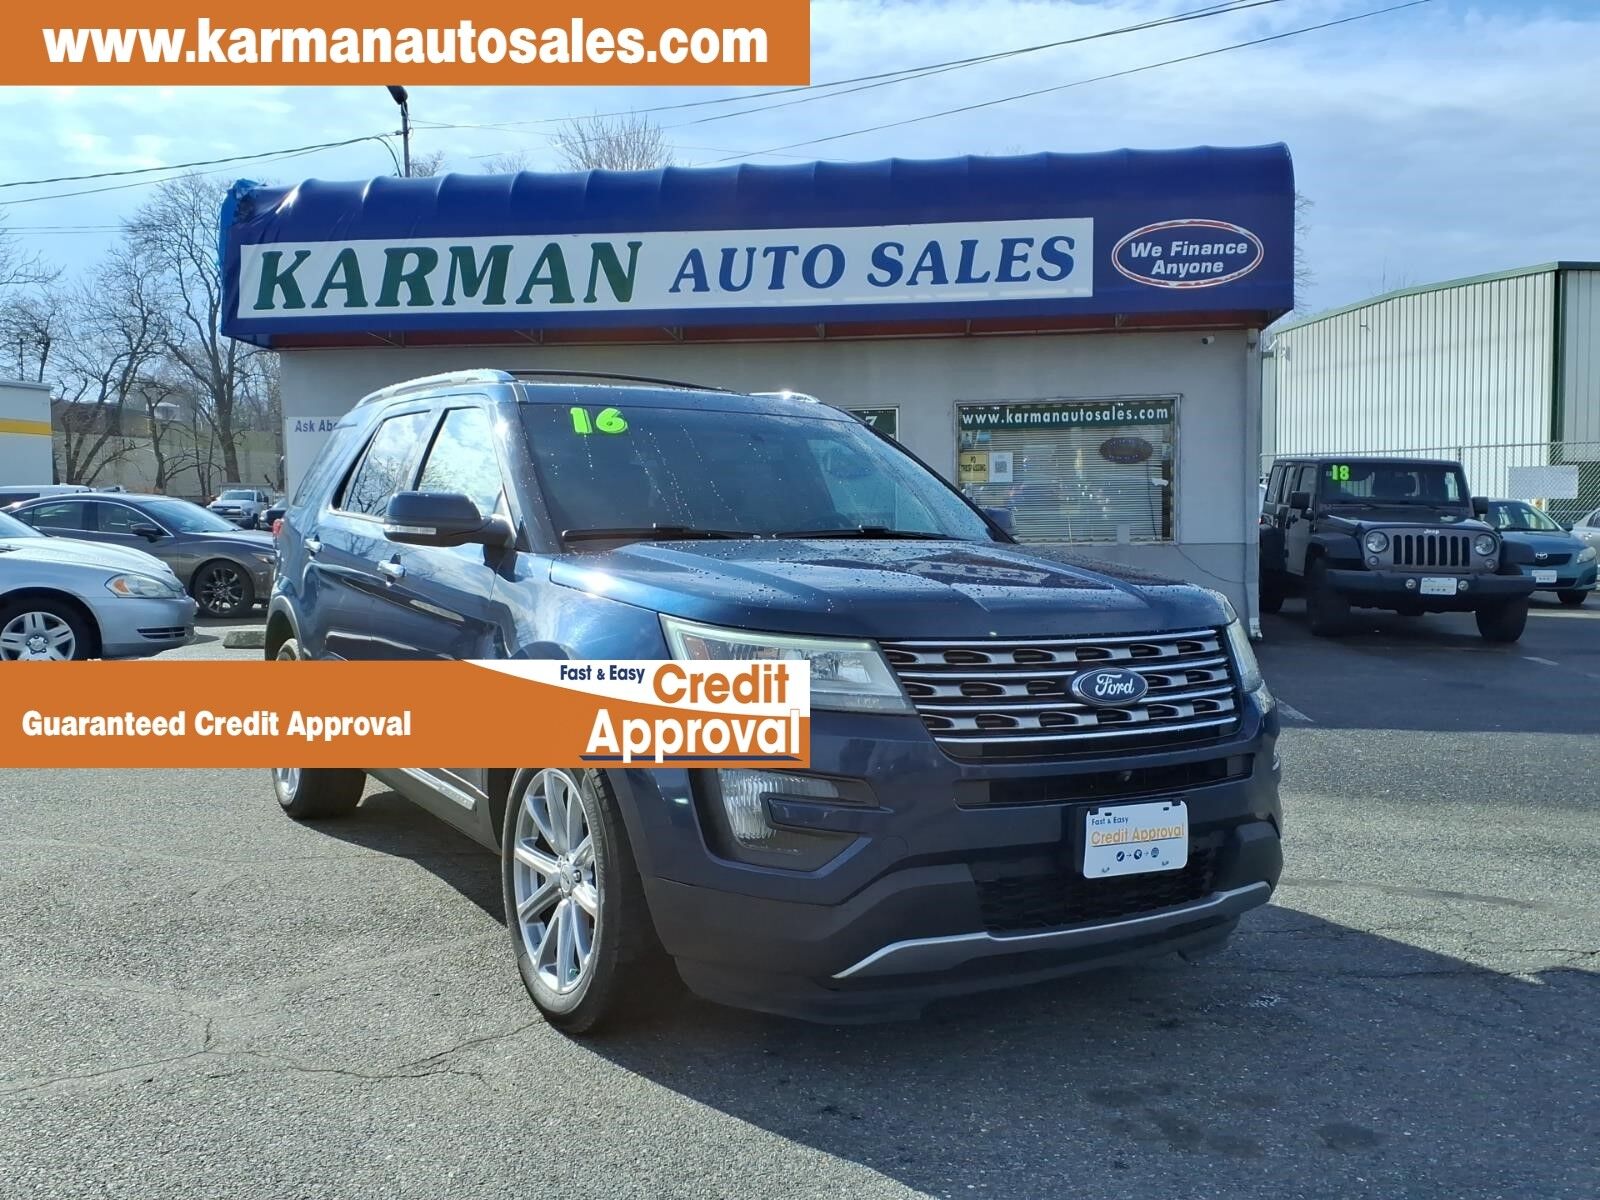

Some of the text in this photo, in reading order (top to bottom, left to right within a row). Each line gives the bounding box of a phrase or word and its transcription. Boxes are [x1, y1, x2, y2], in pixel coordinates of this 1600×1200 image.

[1130, 241, 1248, 258] We Finance
[253, 235, 1076, 310] KARMAN AUTO SALES
[1151, 259, 1224, 278] Anyone
[569, 406, 628, 436] 16
[962, 406, 1169, 425] www.karmanautosales.com
[294, 419, 315, 432] Ask
[1331, 464, 1350, 482] 18
[1095, 673, 1135, 696] Ford
[1091, 817, 1106, 826] Fast
[1113, 815, 1129, 825] Easy
[1091, 822, 1185, 846] Credit Approval
